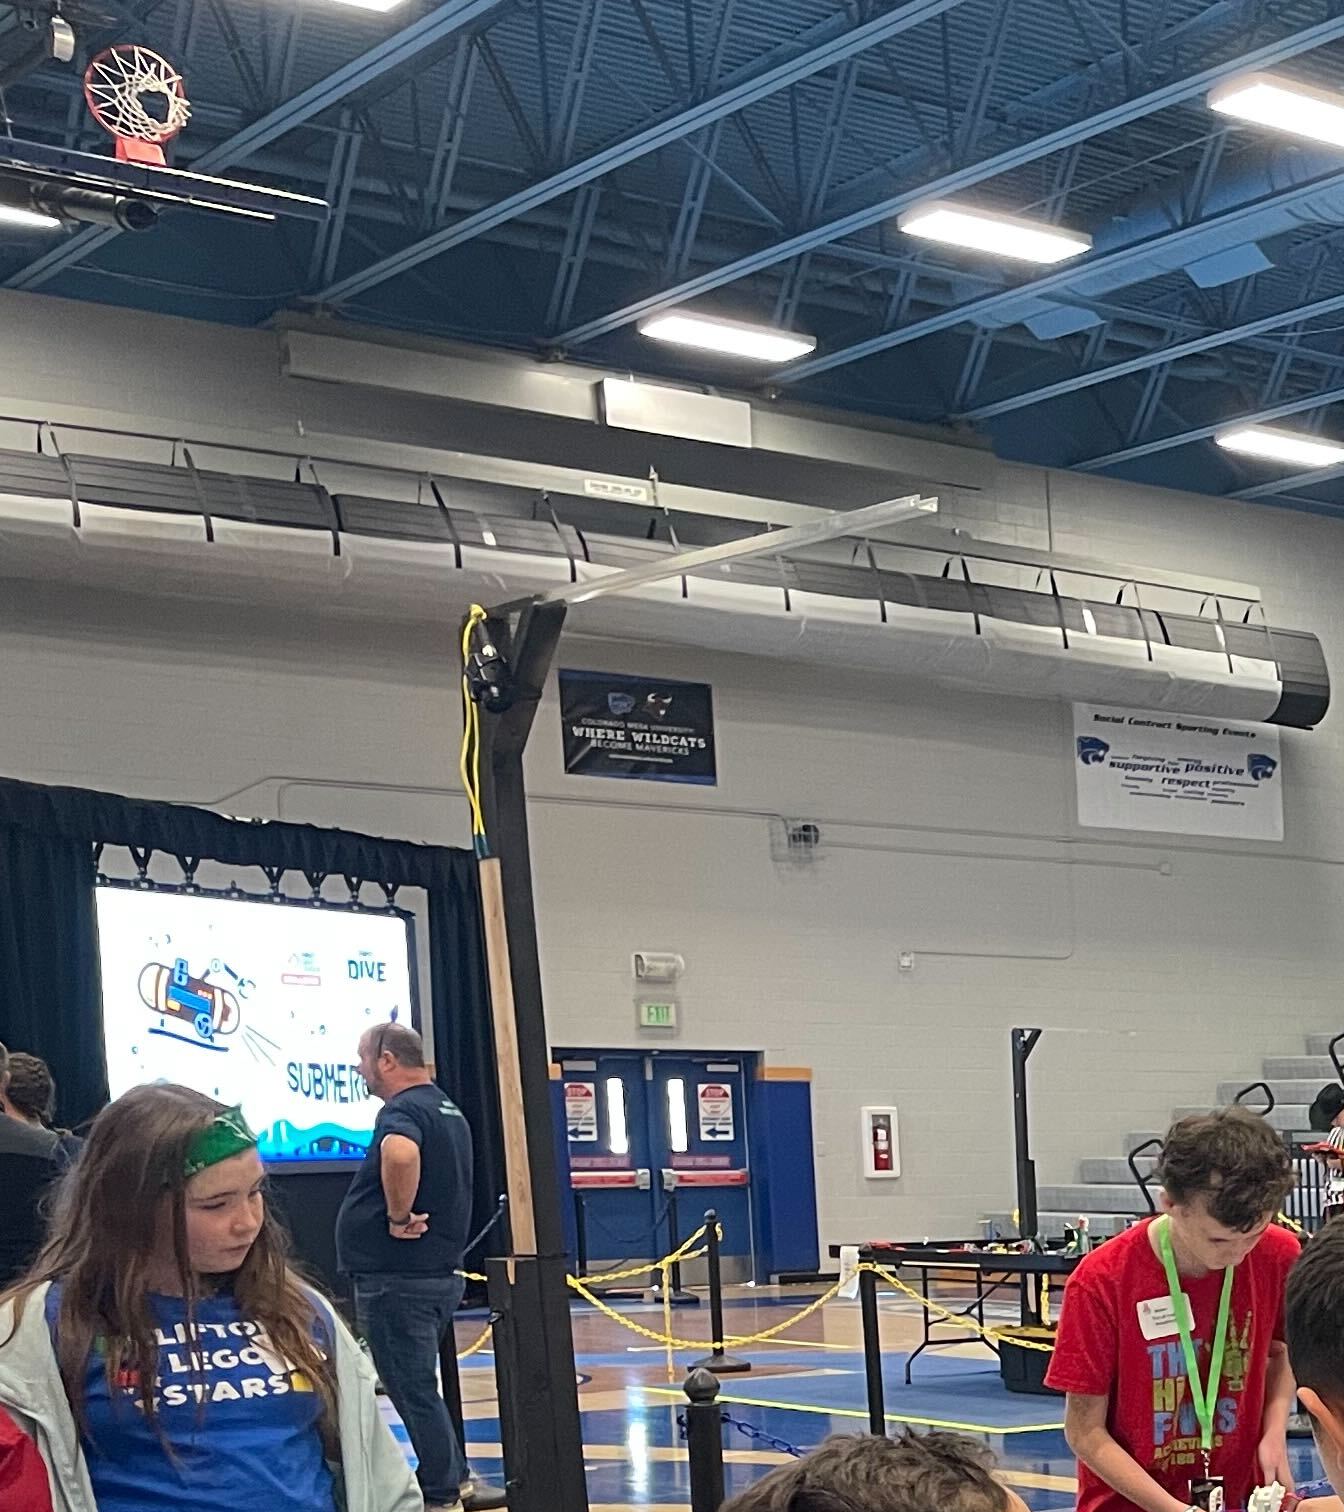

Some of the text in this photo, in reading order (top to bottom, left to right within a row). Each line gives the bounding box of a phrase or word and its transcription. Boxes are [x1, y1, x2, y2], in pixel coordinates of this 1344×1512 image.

[572, 726, 705, 748] WHERE WILDCATS
[1094, 714, 1256, 738] Social Contract Sporting Events
[1109, 761, 1244, 776] supportive positive
[1161, 776, 1211, 788] respect
[348, 960, 387, 982] DIVE
[648, 1006, 670, 1023] EXIT
[168, 1348, 265, 1373] LEGO
[163, 1375, 289, 1406] STARS
